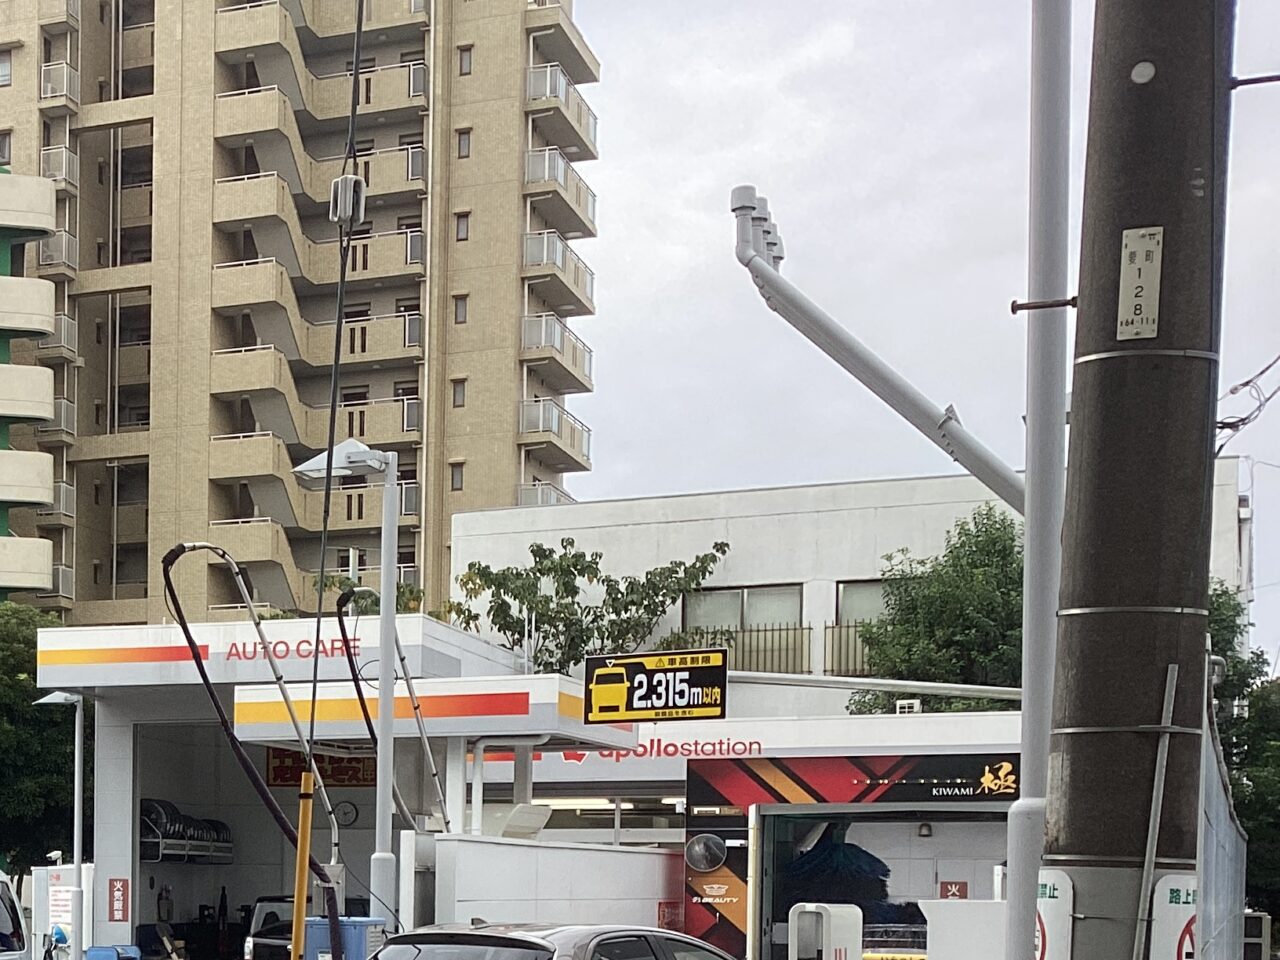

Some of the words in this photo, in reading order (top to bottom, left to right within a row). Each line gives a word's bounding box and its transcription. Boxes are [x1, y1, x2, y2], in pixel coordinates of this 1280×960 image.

[668, 655, 711, 667] 車高制限
[932, 787, 973, 796] KIWAMI
